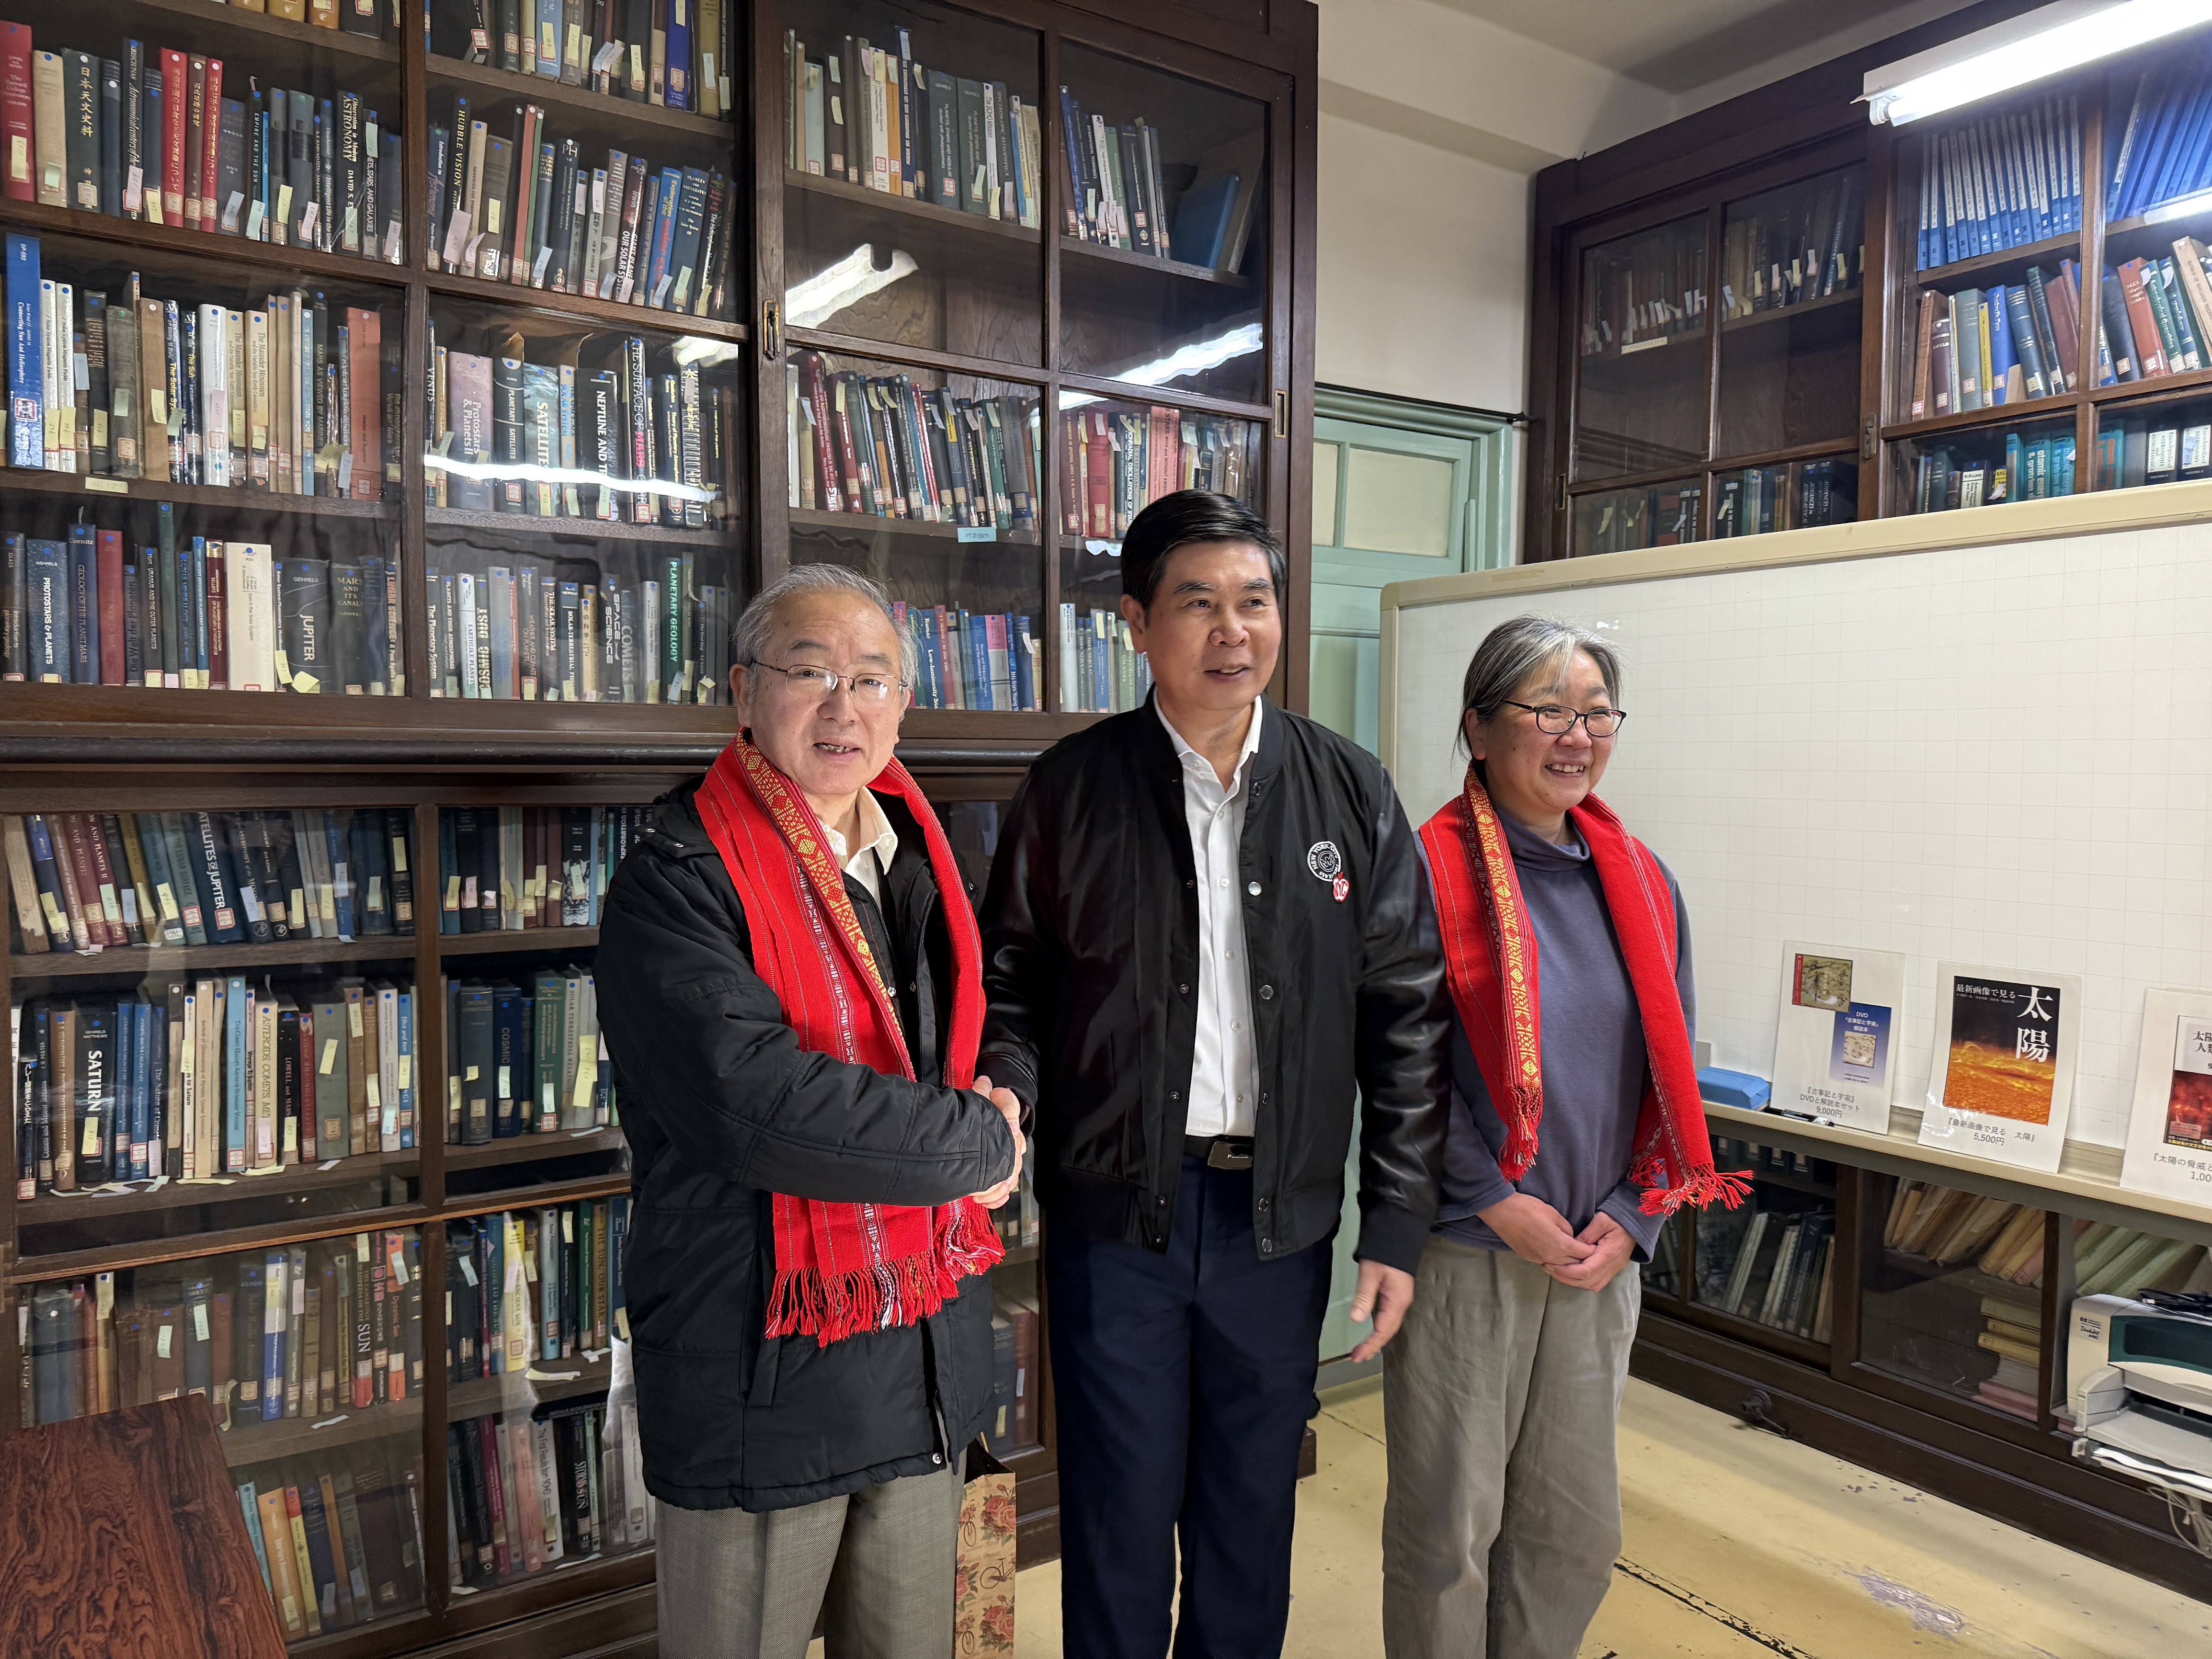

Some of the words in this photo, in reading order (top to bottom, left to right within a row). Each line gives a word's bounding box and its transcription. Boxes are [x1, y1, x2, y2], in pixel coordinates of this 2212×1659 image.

[80, 67, 93, 137] 日本天文史料
[342, 96, 353, 161] ASTRONOMY
[456, 110, 465, 149] HUBBLE
[454, 152, 463, 186] VISION
[666, 179, 678, 217] Exploration
[621, 230, 630, 242] OUR
[618, 242, 629, 268] SOLAR
[2150, 279, 2165, 319] Astrophysical
[2161, 318, 2174, 349] Quantities
[316, 366, 323, 376] AS
[427, 368, 435, 402] VENUS
[633, 363, 644, 412] SURFACE
[316, 406, 323, 414] BY
[463, 398, 473, 408] &
[596, 390, 607, 436] NEPTUNE
[463, 409, 473, 447] Planets
[472, 401, 482, 455] Protostars
[634, 412, 645, 429] OF
[598, 437, 607, 461] AND
[635, 431, 646, 468] MARS
[2037, 450, 2046, 476] atomic
[2027, 460, 2036, 491] grotrian
[1129, 501, 1133, 510] OF
[77, 565, 85, 595] GEOLOGY
[387, 577, 397, 605] LUNAR
[670, 561, 678, 614] PLANETARY
[43, 577, 51, 624] PROTOSTARS
[299, 614, 316, 662] JUPITER
[428, 619, 436, 653] Planetary
[477, 607, 489, 638] DUST
[605, 606, 614, 664] SCIENCE
[45, 632, 53, 665] PLANETS
[622, 625, 634, 682] COMETS
[670, 618, 678, 662] GEOLOGY
[429, 653, 437, 680] System
[928, 649, 938, 698] Low-luminosity
[91, 825, 99, 841] AND
[198, 811, 217, 861] ATELLITES
[1312, 843, 1330, 853] YORK
[1310, 854, 1318, 870] NEW
[1330, 845, 1339, 859] CITY
[206, 867, 226, 909] JUPITER
[1956, 983, 2017, 1000] 最新画像で見る
[262, 1016, 271, 1061] ASTEROIDS,
[1845, 1017, 1879, 1028] 「古事記と宇宙」
[2015, 986, 2054, 1063] 太陽
[501, 1027, 510, 1064] COSMIC
[88, 1050, 103, 1112] SATURN
[262, 1064, 271, 1099] COMETS,
[1808, 1086, 1855, 1103] 『古事記と宇宙』
[1800, 1094, 1860, 1112] DVDと解説本セット
[1816, 1105, 1843, 1119] 9,000円
[1948, 1116, 2007, 1136] 『最新画像で見る
[2014, 1131, 2036, 1143] 太陽』
[1973, 1133, 2005, 1146] 5,500円
[391, 1295, 399, 1323] Dynamic
[358, 1323, 370, 1352] SUN
